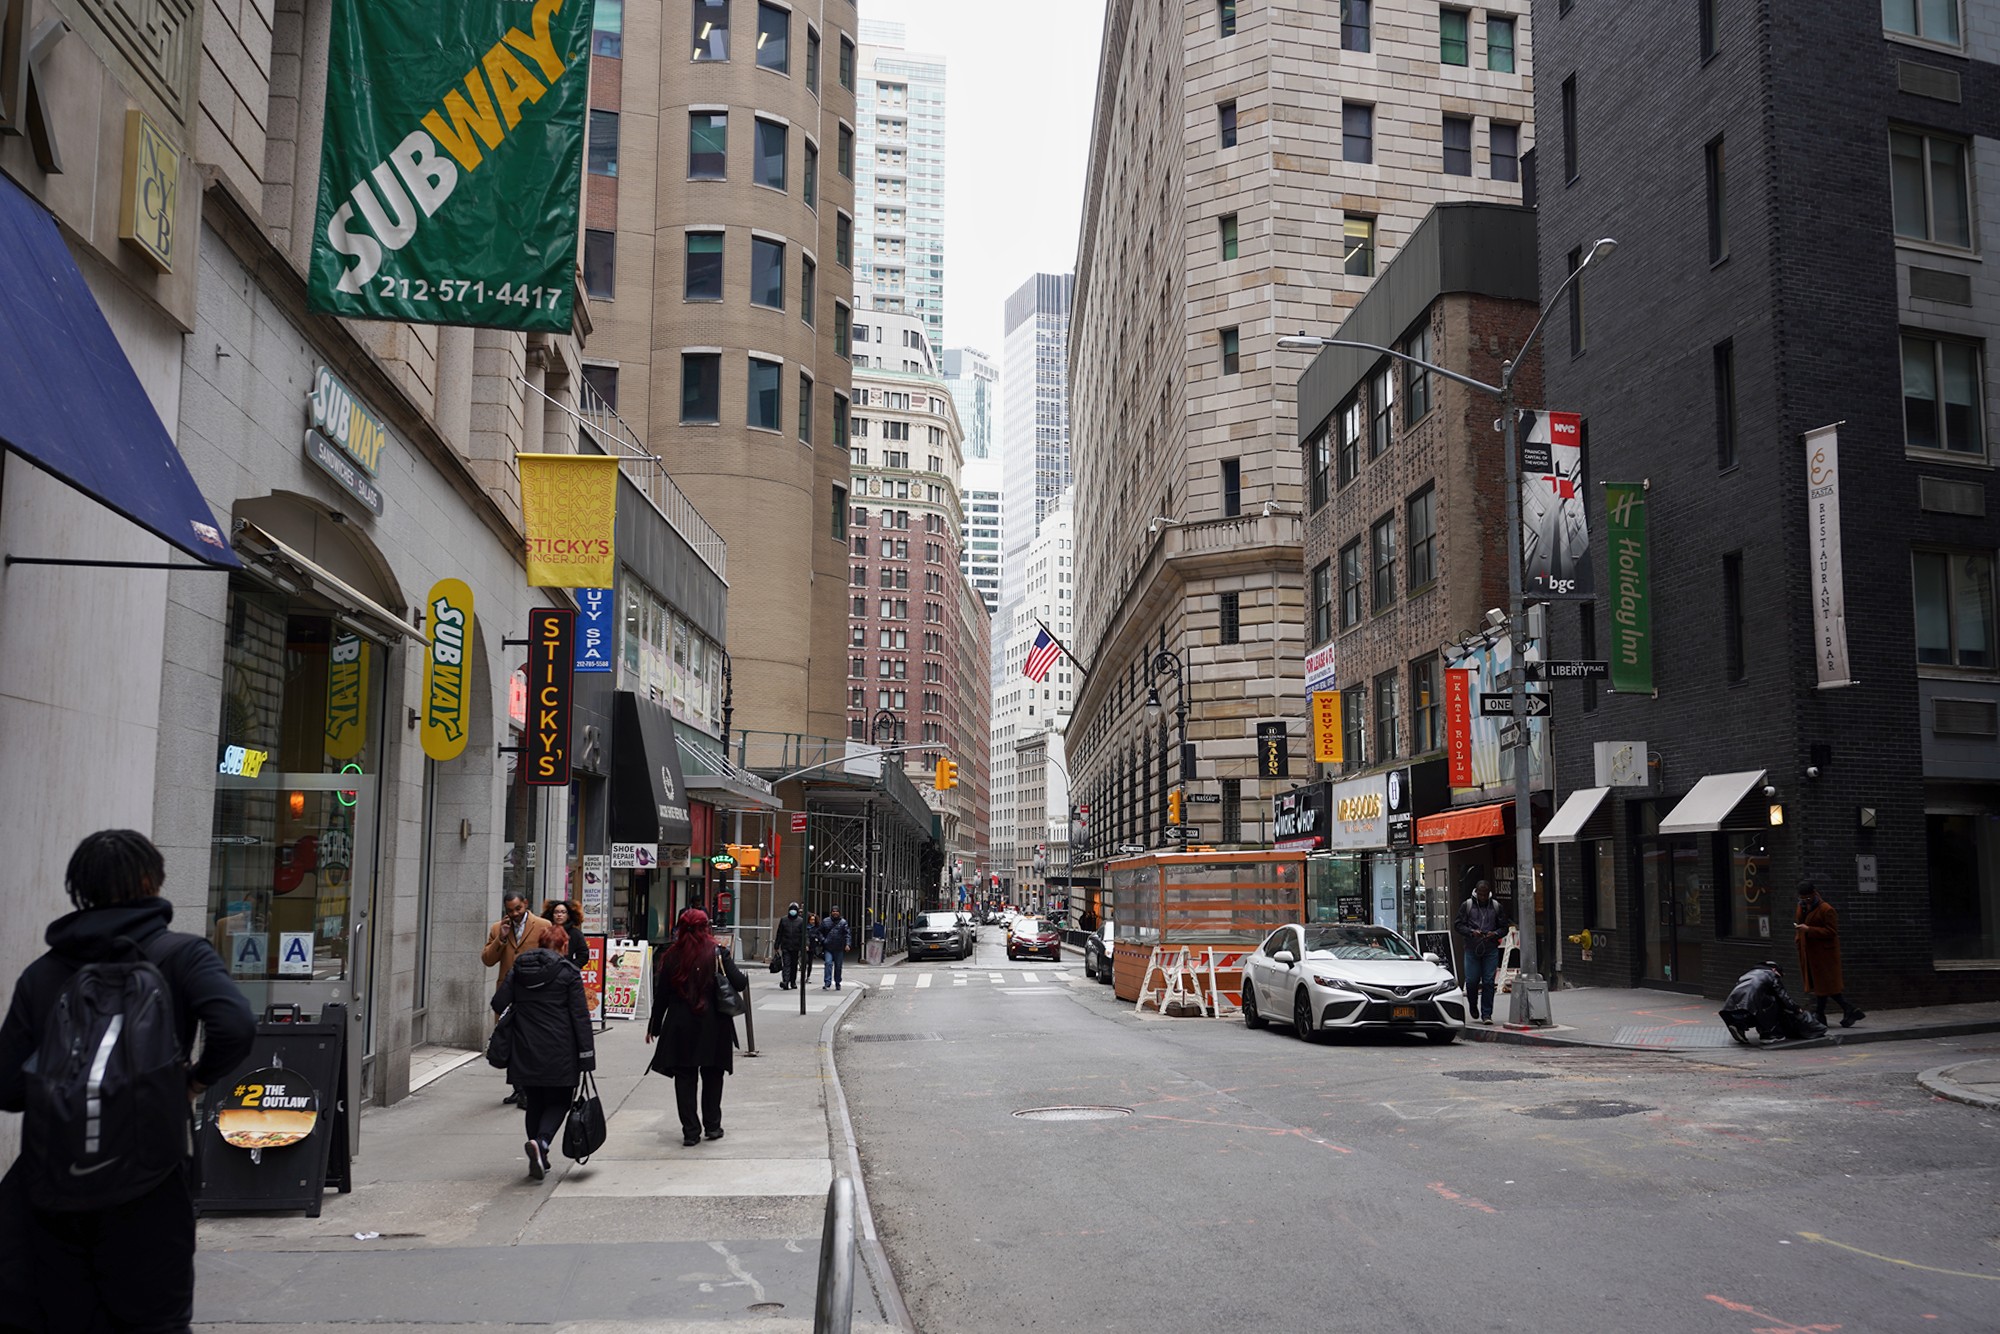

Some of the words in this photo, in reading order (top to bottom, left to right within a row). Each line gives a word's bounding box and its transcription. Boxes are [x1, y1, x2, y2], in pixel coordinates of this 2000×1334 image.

[328, 0, 567, 295] SUBWAY
[312, 371, 386, 472] SUBWAY
[1553, 423, 1576, 434] NYC
[319, 442, 354, 487] SANDWICHES
[357, 479, 378, 508] SALADS
[524, 462, 612, 480] STICKY'S
[524, 478, 612, 495] STICKY'S
[1811, 487, 1834, 498] PASTA
[523, 493, 611, 510] STICKY'S
[523, 508, 611, 525] STICKY'S
[525, 523, 610, 540] STICKY'S
[525, 538, 609, 555] STICKY'S
[571, 554, 607, 564] JOINT
[1549, 575, 1575, 594] bgc
[1615, 537, 1642, 627] Holiday
[1819, 503, 1831, 620] RESTAURANT
[1825, 637, 1835, 671] BAR
[586, 588, 602, 621] UTY
[585, 628, 601, 658] SPA
[1621, 628, 1644, 665] Inn
[430, 597, 464, 742] SUBWAY
[1551, 665, 1589, 676] LIBERTY
[539, 617, 563, 776] STICKY'S
[1320, 698, 1333, 709] WE
[1454, 682, 1462, 723] KATI
[1490, 700, 1511, 710] ONE
[1527, 699, 1541, 710] AY
[1322, 712, 1332, 729] BUY
[1322, 733, 1334, 756] GOLD
[1455, 730, 1464, 772] ROLL
[219, 744, 268, 778] SUBWAY
[1268, 740, 1279, 776] SALON
[1169, 828, 1180, 837] ONE
[1187, 828, 1198, 837] WAY
[613, 845, 635, 853] SHOE
[711, 854, 734, 864] PIZZA
[1761, 916, 1768, 932] A
[238, 937, 262, 962] A
[284, 937, 307, 962] A
[608, 986, 631, 1005] $55
[234, 1084, 264, 1107] #2
[265, 1085, 286, 1096] THE
[262, 1096, 310, 1108] OUTLAW
